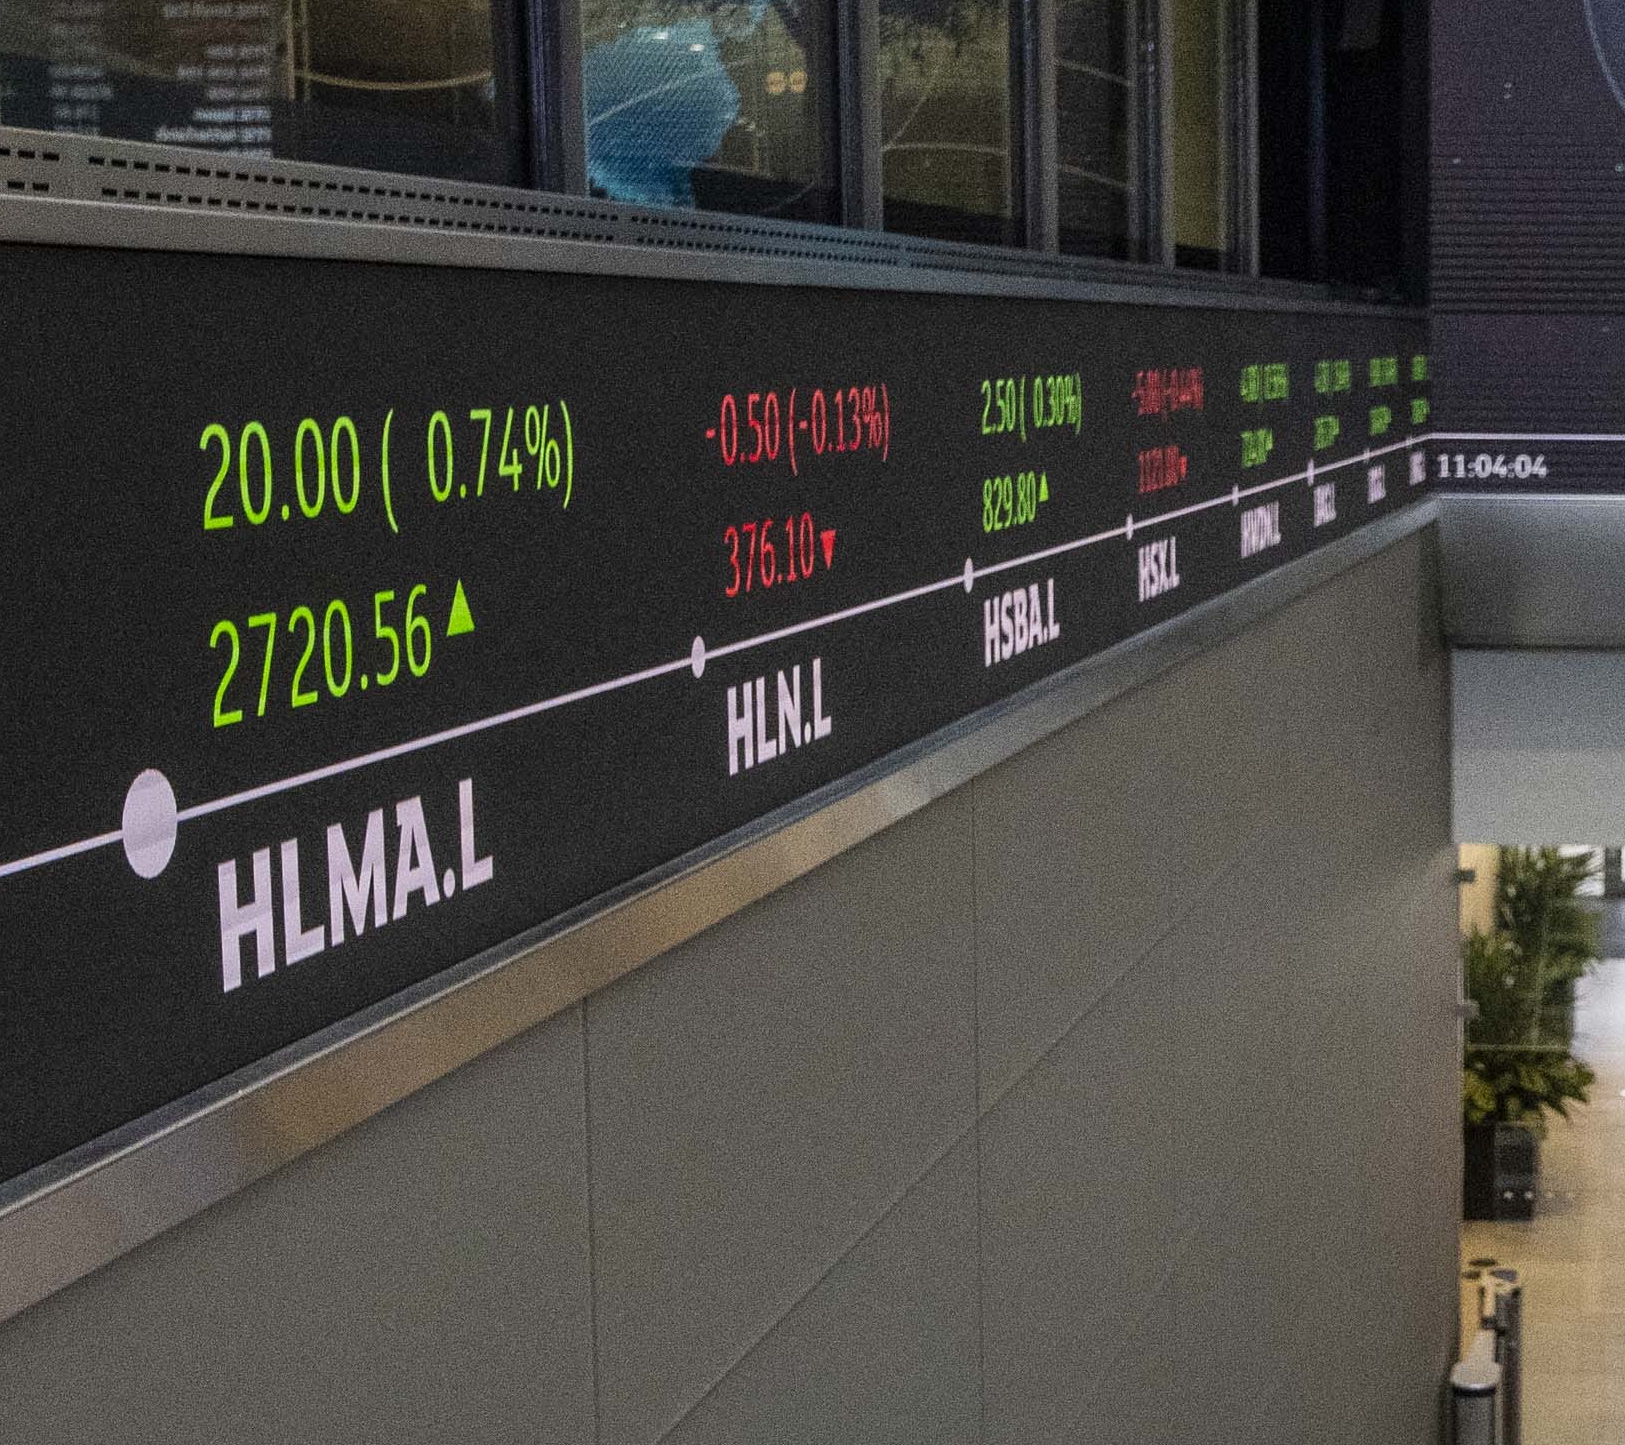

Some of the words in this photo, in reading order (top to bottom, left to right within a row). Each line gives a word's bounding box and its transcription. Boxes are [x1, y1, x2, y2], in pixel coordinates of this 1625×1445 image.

[705, 391, 780, 466] -0.50
[787, 382, 891, 476] (-0.13%)
[980, 377, 1016, 436] 2.50
[199, 416, 361, 530] 20.00
[982, 470, 1037, 533] 829.80
[1438, 454, 1548, 478] 11:04:04
[723, 512, 814, 597] 376.10
[209, 583, 432, 728] 2720.56
[984, 578, 1061, 667] HSBA.L
[727, 658, 832, 776] HLN.L
[217, 778, 493, 994] HLMA.L
